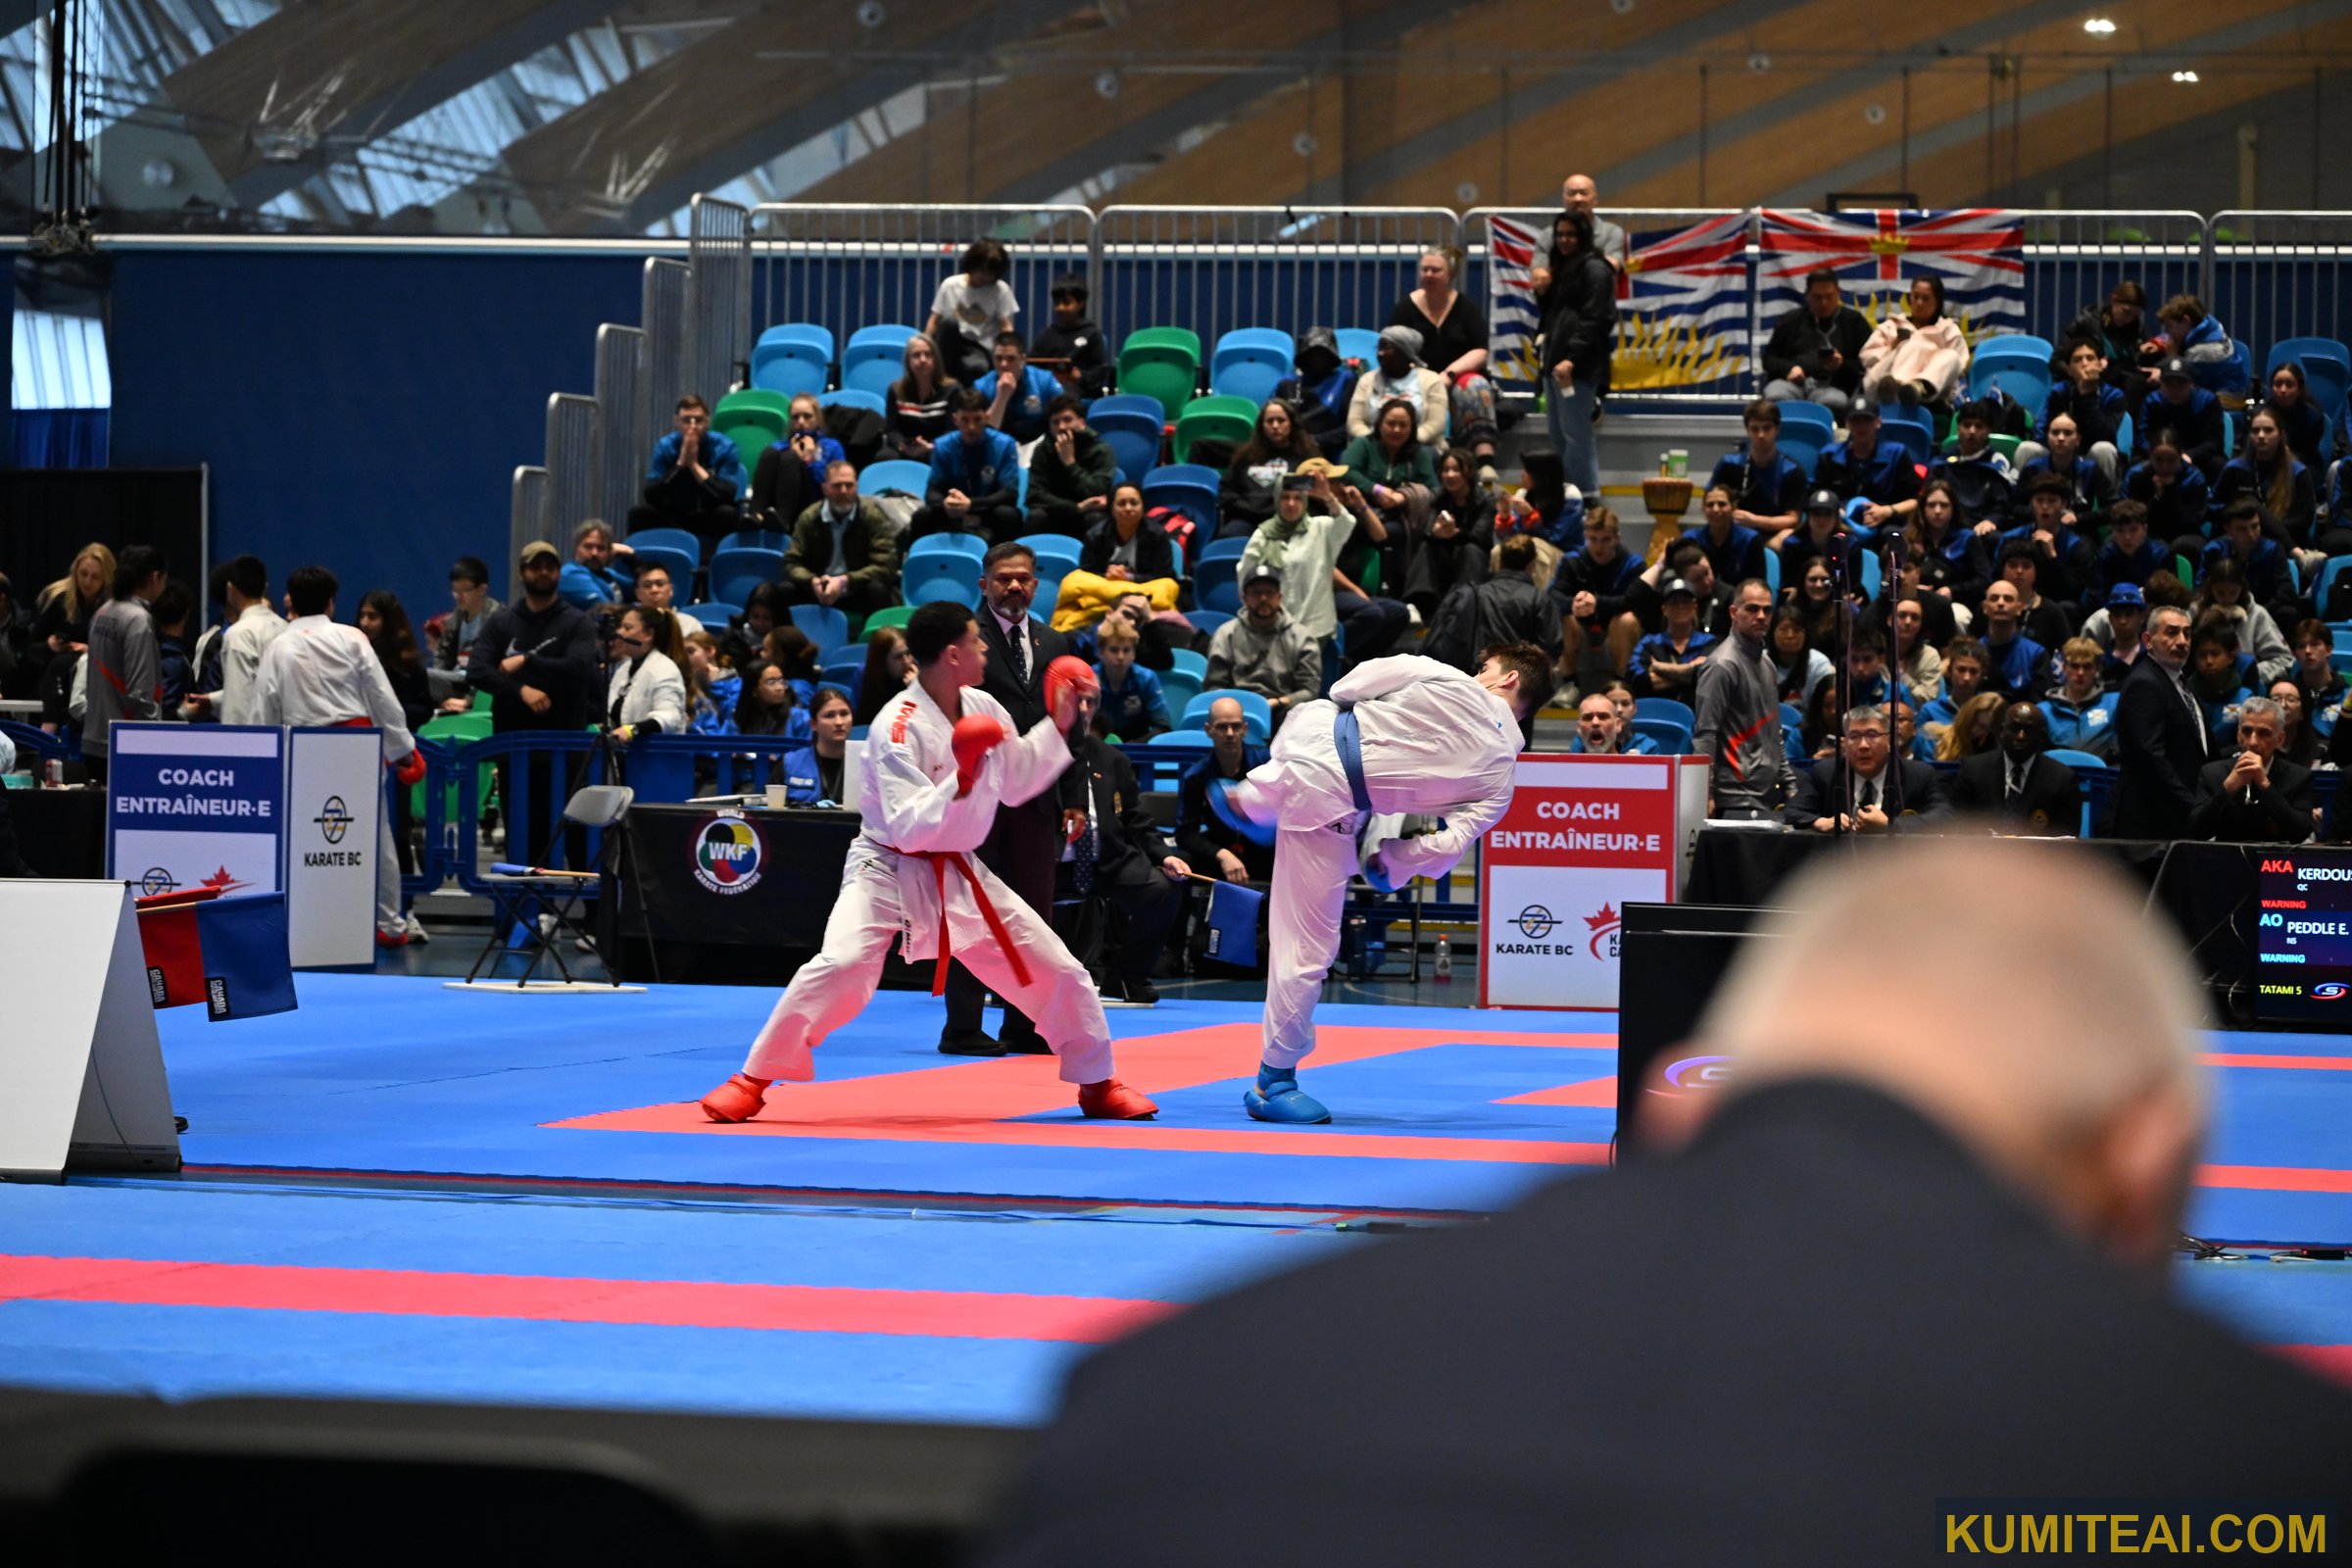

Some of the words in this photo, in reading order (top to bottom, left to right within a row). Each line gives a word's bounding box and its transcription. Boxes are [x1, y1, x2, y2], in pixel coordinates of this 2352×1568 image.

[158, 768, 234, 787] COACH
[116, 794, 271, 817] ENTRAÎNEUR·E
[1536, 801, 1620, 820] COACH
[1490, 827, 1661, 852] ENTRAÎNEUR·E
[709, 842, 748, 861] WKF
[304, 852, 345, 867] KARATE
[347, 851, 362, 866] BC
[2261, 859, 2293, 873] AKA
[2261, 900, 2307, 909] WARNING
[2259, 913, 2283, 927] AO
[2287, 921, 2335, 935] PEDDLE
[2338, 923, 2349, 935] E.
[1495, 944, 1551, 956] KARATE
[1554, 945, 1574, 956] BC
[2260, 954, 2306, 963] WARNING
[2259, 985, 2294, 995] TATAMI
[2296, 986, 2302, 995] 5
